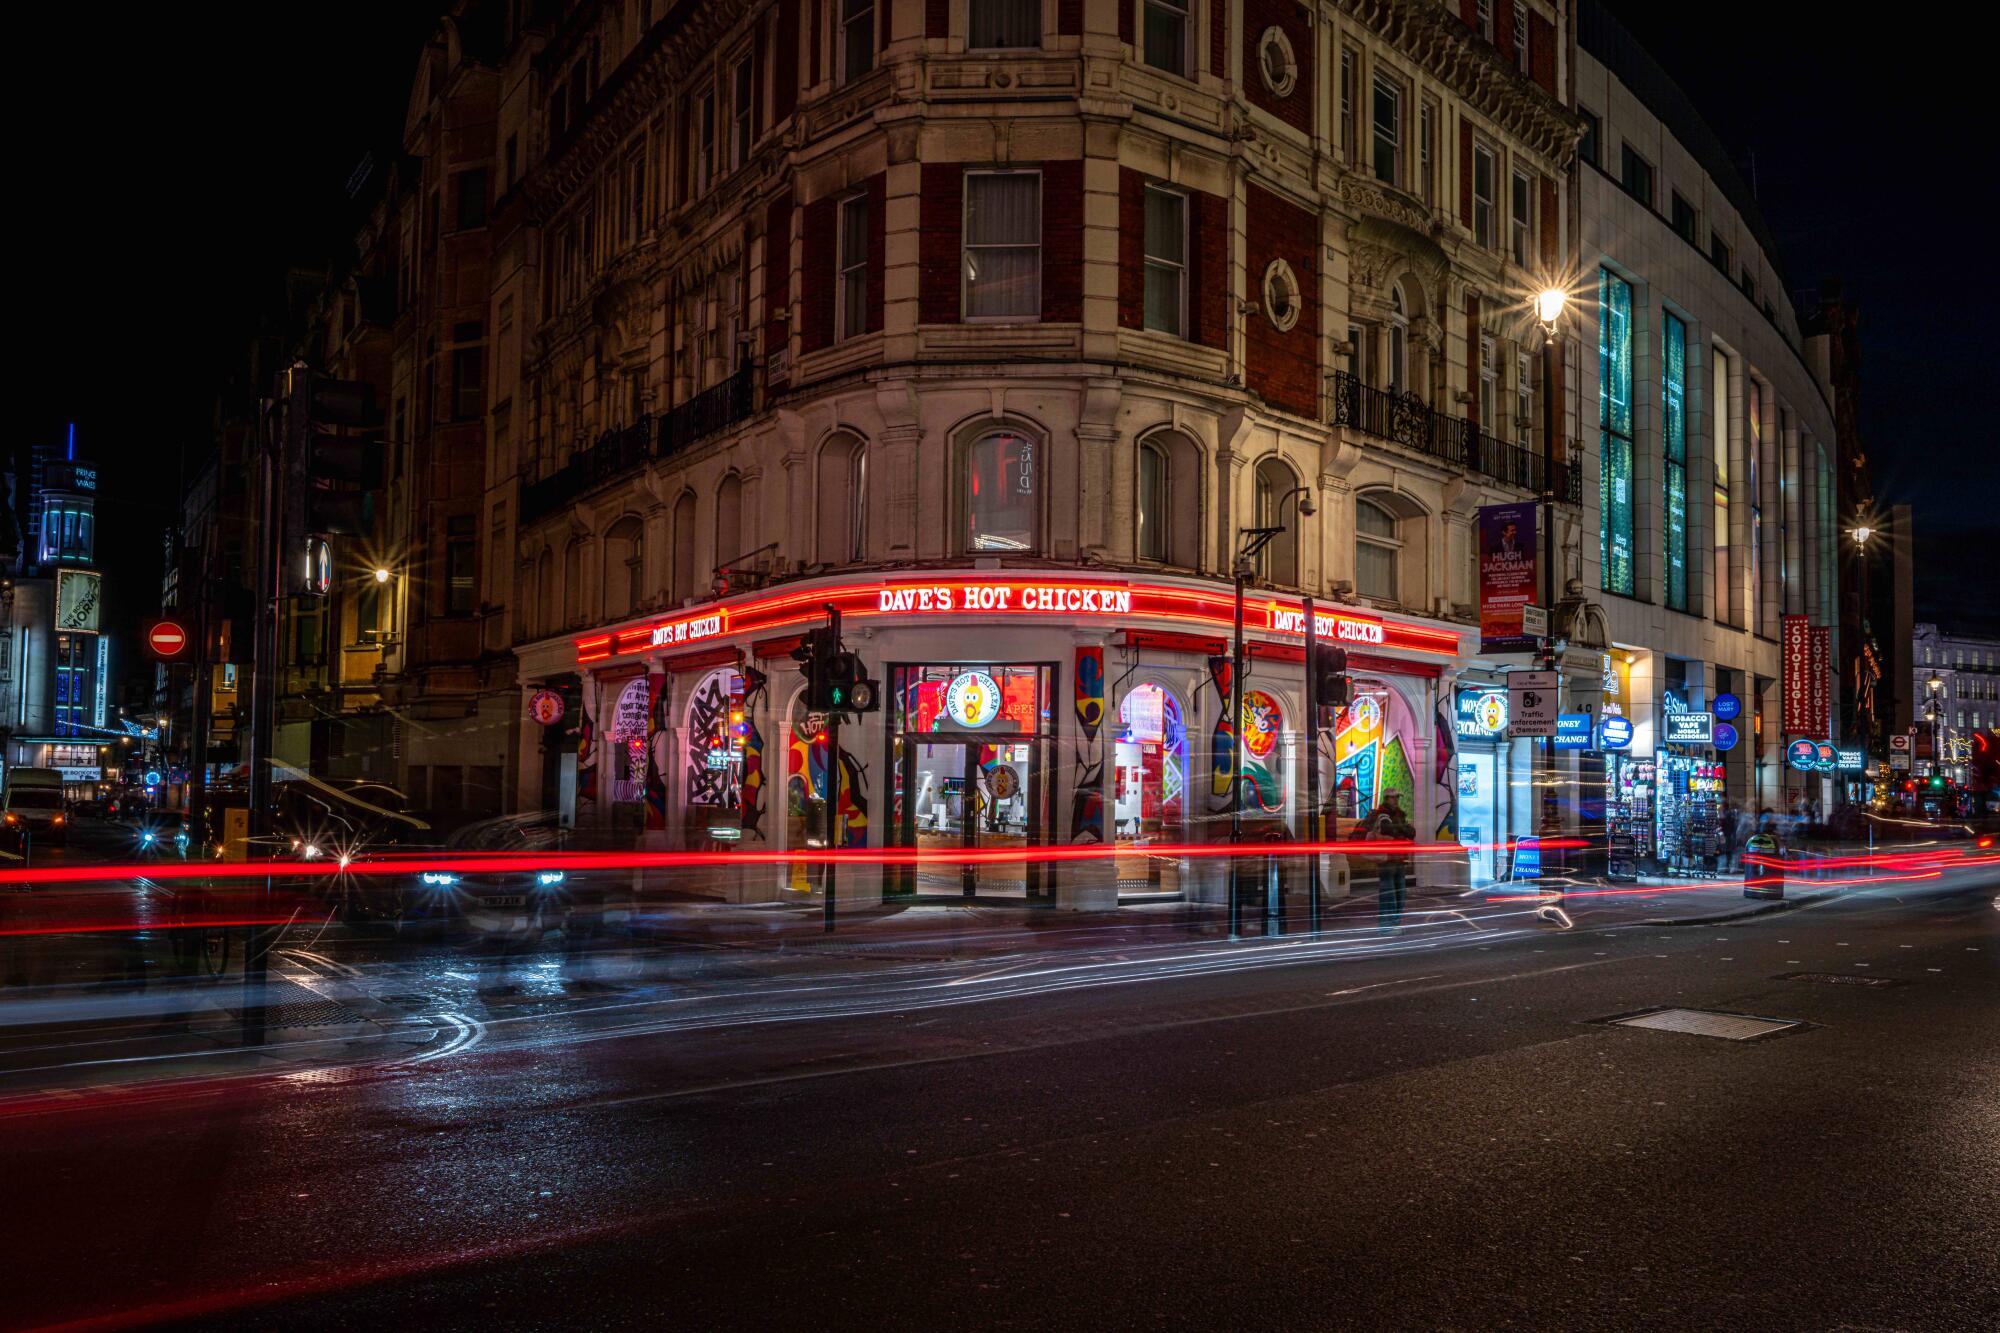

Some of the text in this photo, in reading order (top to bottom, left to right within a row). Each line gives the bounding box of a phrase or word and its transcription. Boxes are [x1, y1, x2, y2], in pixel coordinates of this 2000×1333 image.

[1482, 560, 1534, 573] JACKMAN
[1492, 552, 1522, 562] HUGH
[880, 586, 1130, 612] DAVE'S HOT CHICKEN
[653, 615, 720, 645] DAVE'S HOT CHICKEN
[1315, 616, 1334, 636] HOT
[1337, 620, 1382, 643] CHICKEN
[948, 675, 997, 715] DAVE'S HOT CHICKEN
[1511, 718, 1555, 726] enforcement
[1557, 720, 1581, 729] ONEY
